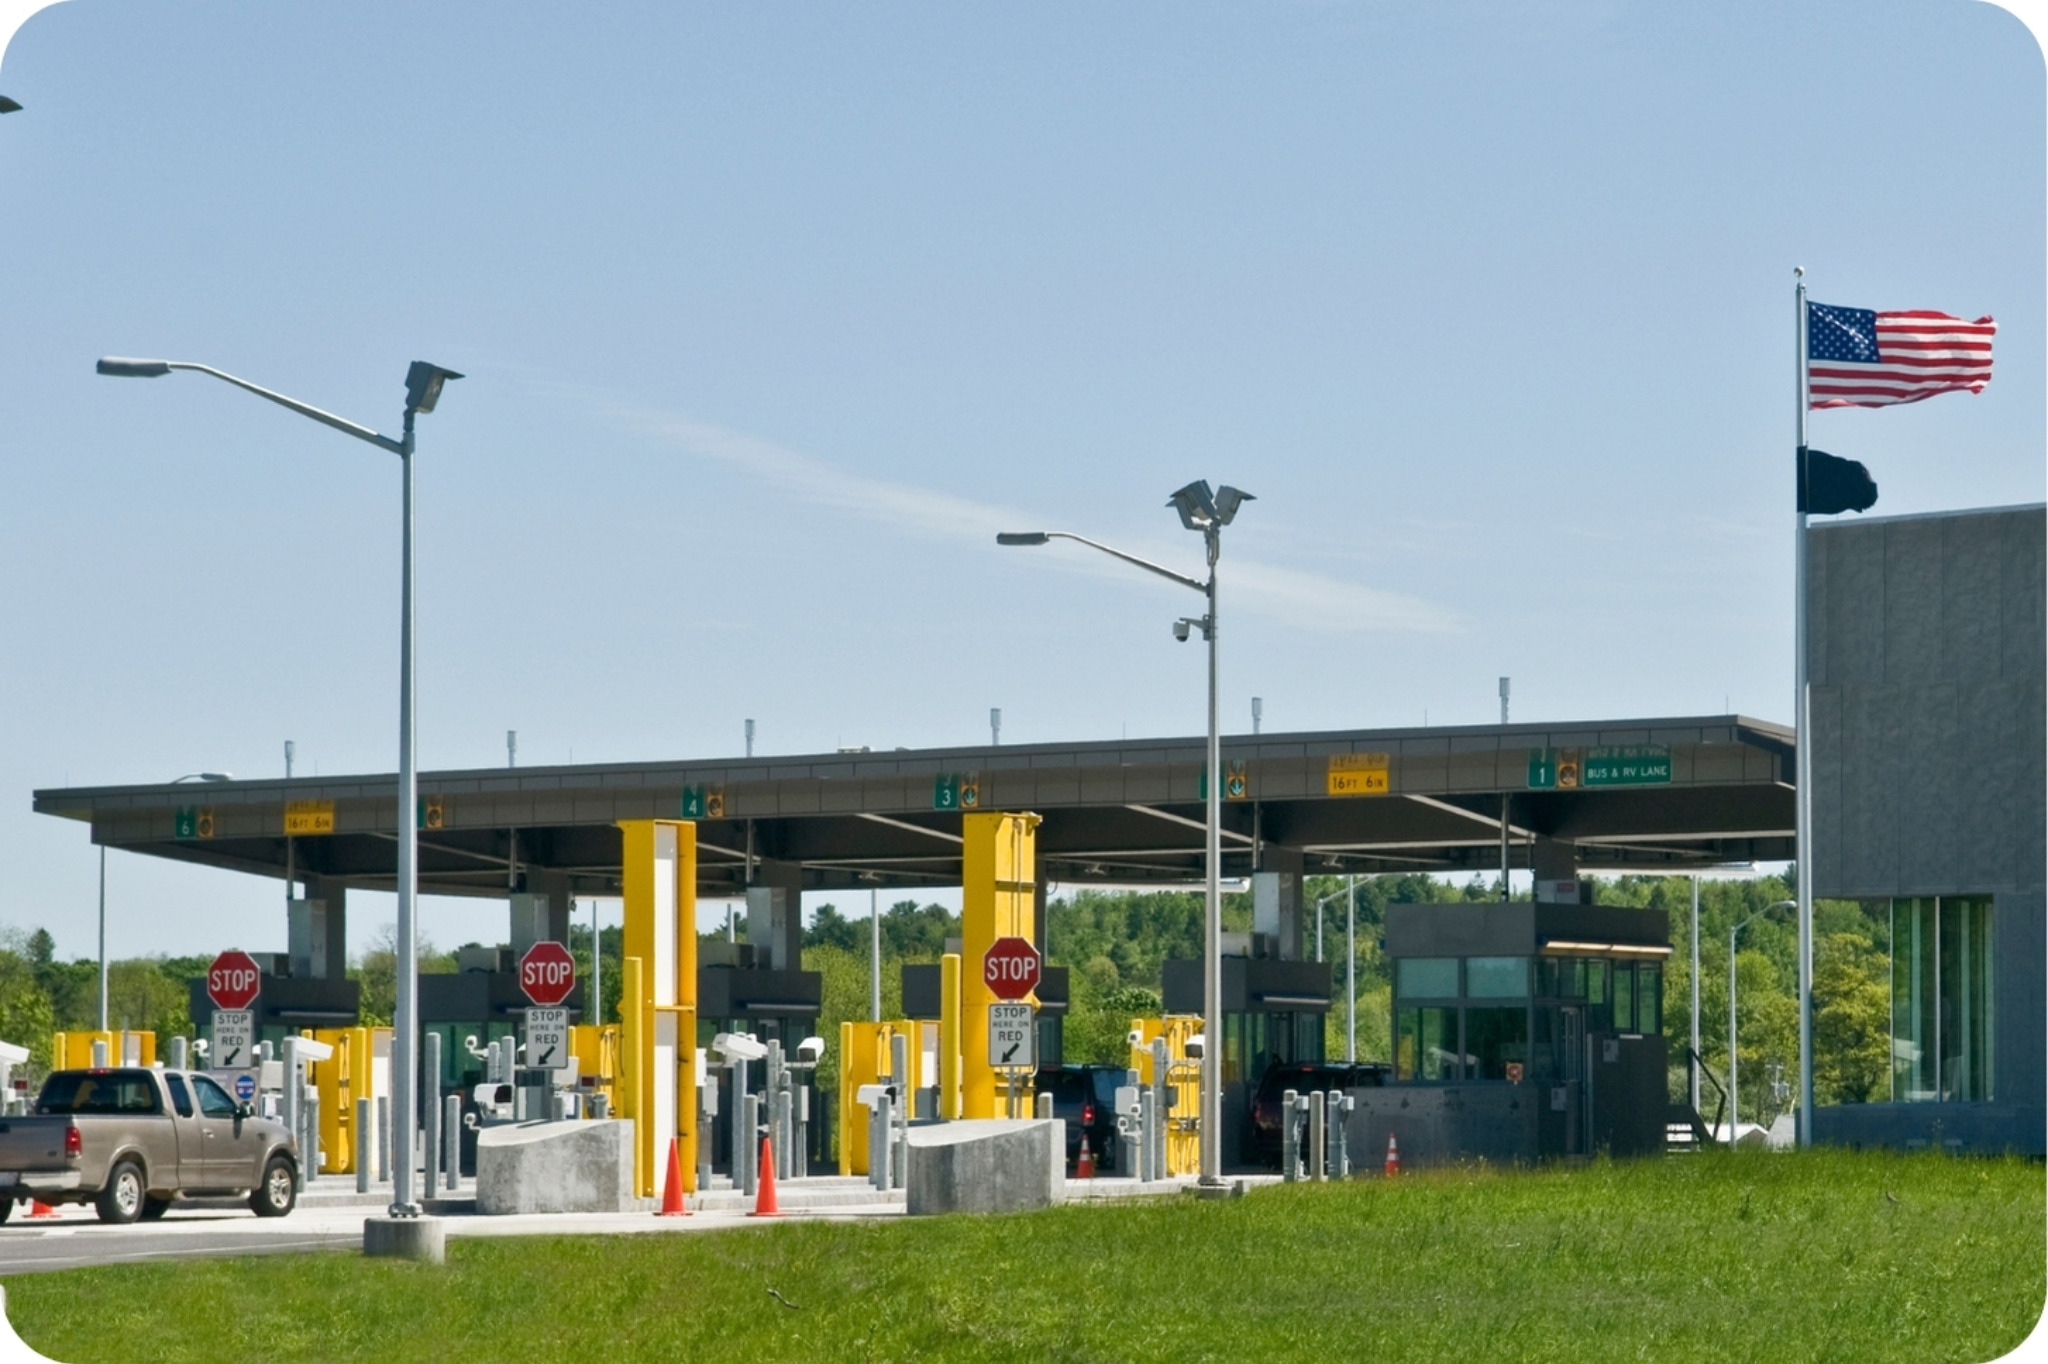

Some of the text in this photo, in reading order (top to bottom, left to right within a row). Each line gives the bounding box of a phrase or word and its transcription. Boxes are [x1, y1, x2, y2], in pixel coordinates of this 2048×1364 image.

[1539, 767, 1545, 784] 1
[1587, 766, 1668, 779] BUS & RV LANE
[942, 790, 951, 806] 3
[688, 800, 697, 814] 4
[181, 822, 189, 835] 6
[524, 962, 571, 985] STOP
[987, 957, 1036, 980] STOP
[211, 969, 256, 991] STOP
[532, 1011, 563, 1021] STOP
[994, 1007, 1027, 1018] STOP
[218, 1015, 248, 1024] STOP
[221, 1036, 244, 1046] RED
[535, 1034, 559, 1044] RED
[998, 1031, 1023, 1041] RED
